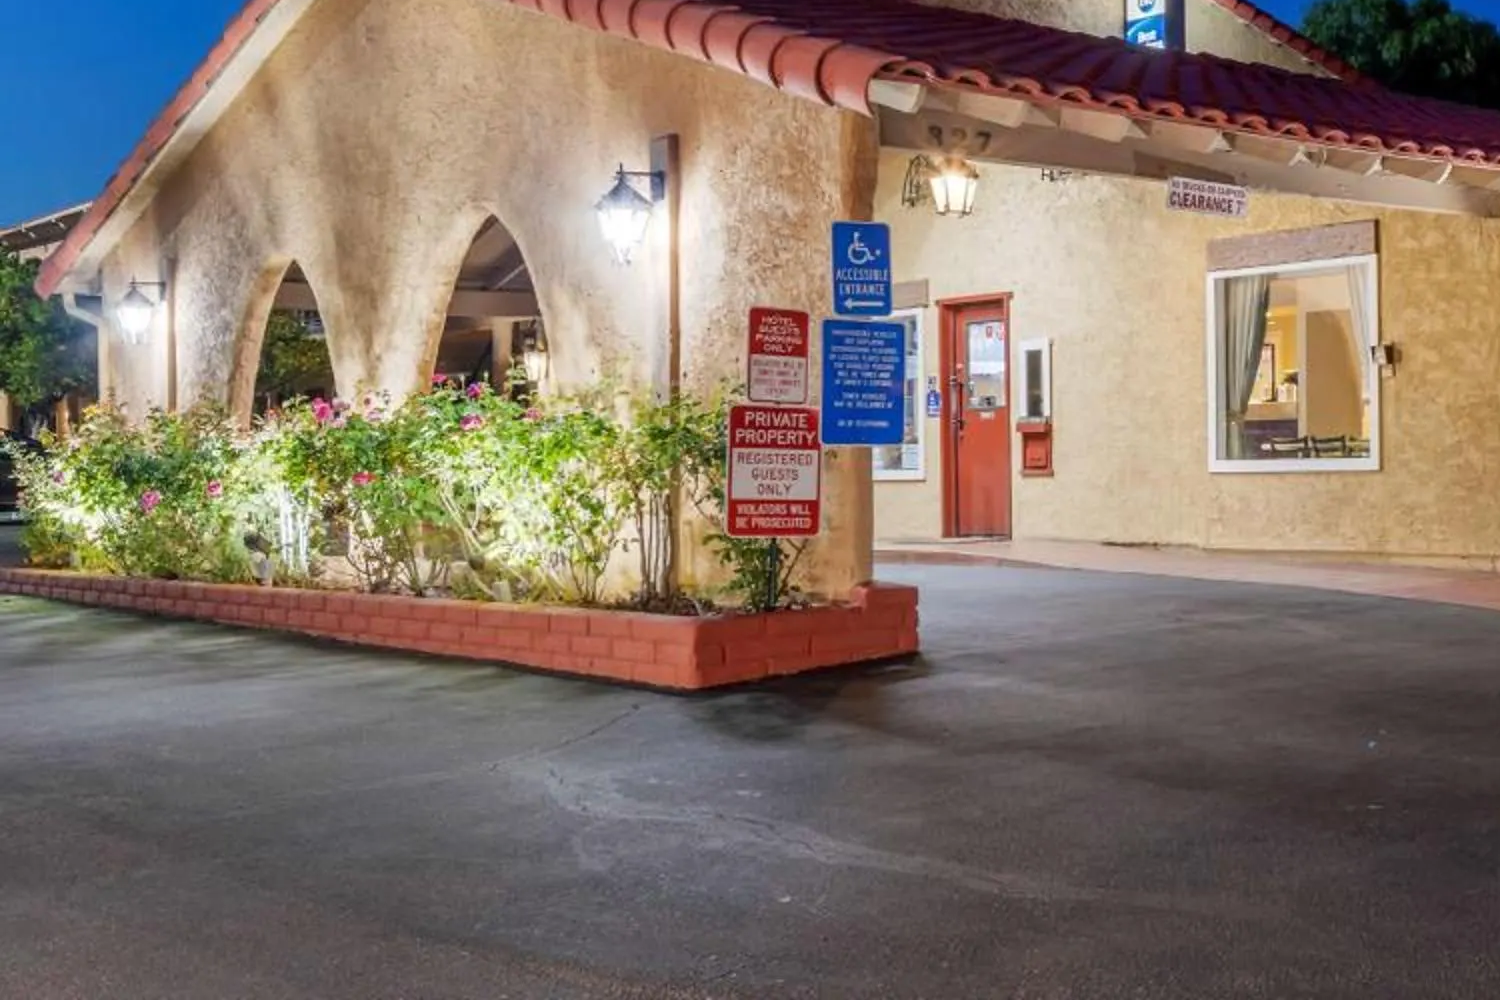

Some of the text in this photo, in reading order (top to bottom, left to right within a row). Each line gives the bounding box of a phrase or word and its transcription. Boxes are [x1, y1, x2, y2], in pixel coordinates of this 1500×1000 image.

[1169, 191, 1234, 215] CLEARANCE
[836, 268, 888, 281] ACCESSIBLE
[839, 283, 885, 296] ENTRANCE
[763, 343, 795, 353] ONLY
[745, 411, 808, 428] PRIVATE
[735, 429, 816, 446] PROPERTY
[737, 452, 813, 466] REGISTERED
[751, 467, 799, 481] GUESTS
[757, 482, 792, 496] ONLY
[736, 503, 811, 515] VIOLATORS WILL
